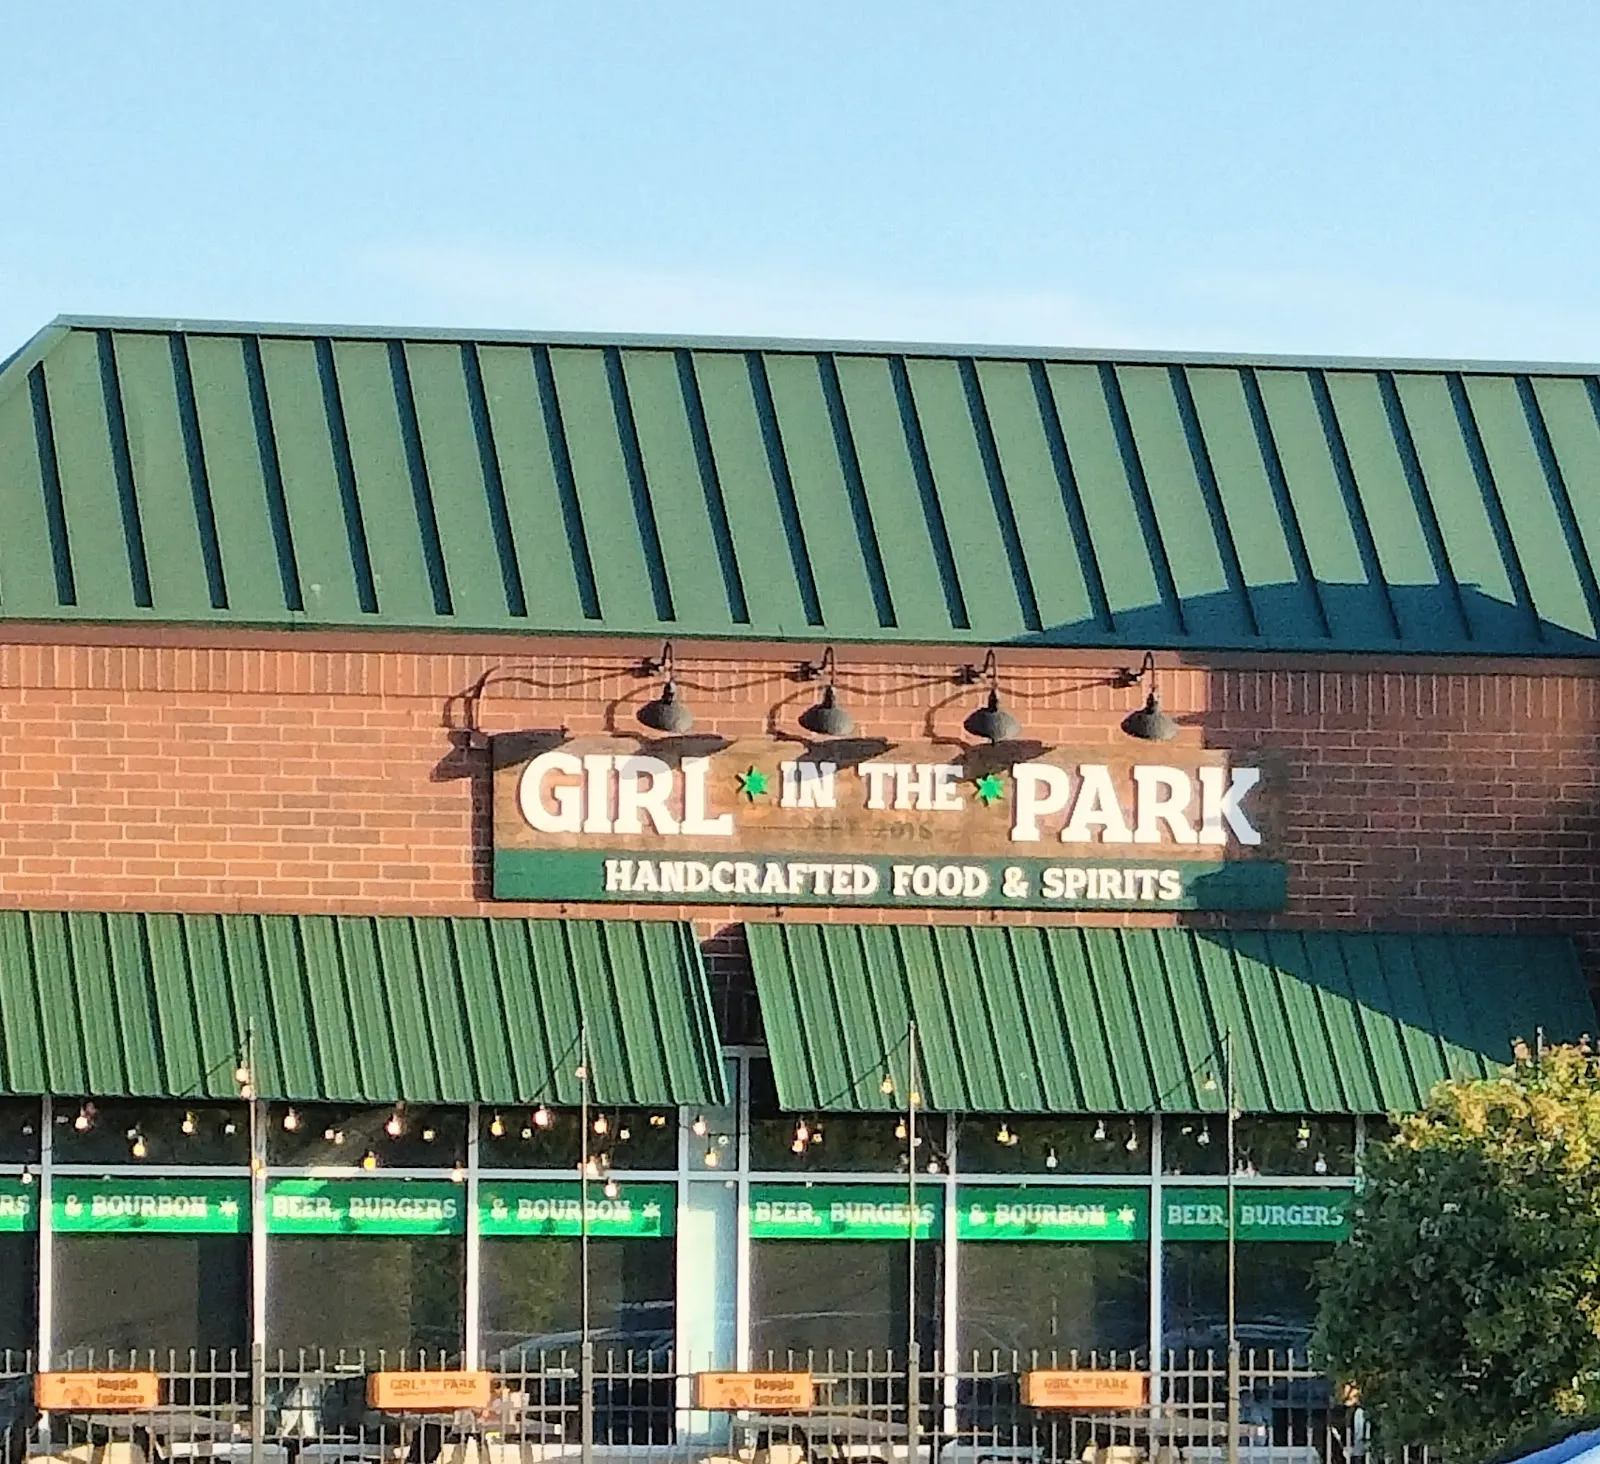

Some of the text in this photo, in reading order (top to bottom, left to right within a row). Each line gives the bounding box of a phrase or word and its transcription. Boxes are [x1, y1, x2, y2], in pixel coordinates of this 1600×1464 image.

[520, 751, 1262, 846] GIRL IN THE PARK
[603, 859, 1182, 901] HANDCRAFTED FOOD & SPIRITS
[64, 1195, 208, 1218] & BOURBON
[272, 1196, 458, 1221] BEER, BURGERS
[490, 1199, 633, 1222] & BOURBON
[754, 1202, 935, 1226] BEER, BURGERS
[969, 1204, 1107, 1226] & BOURBON
[1239, 1204, 1345, 1227] BURGERS
